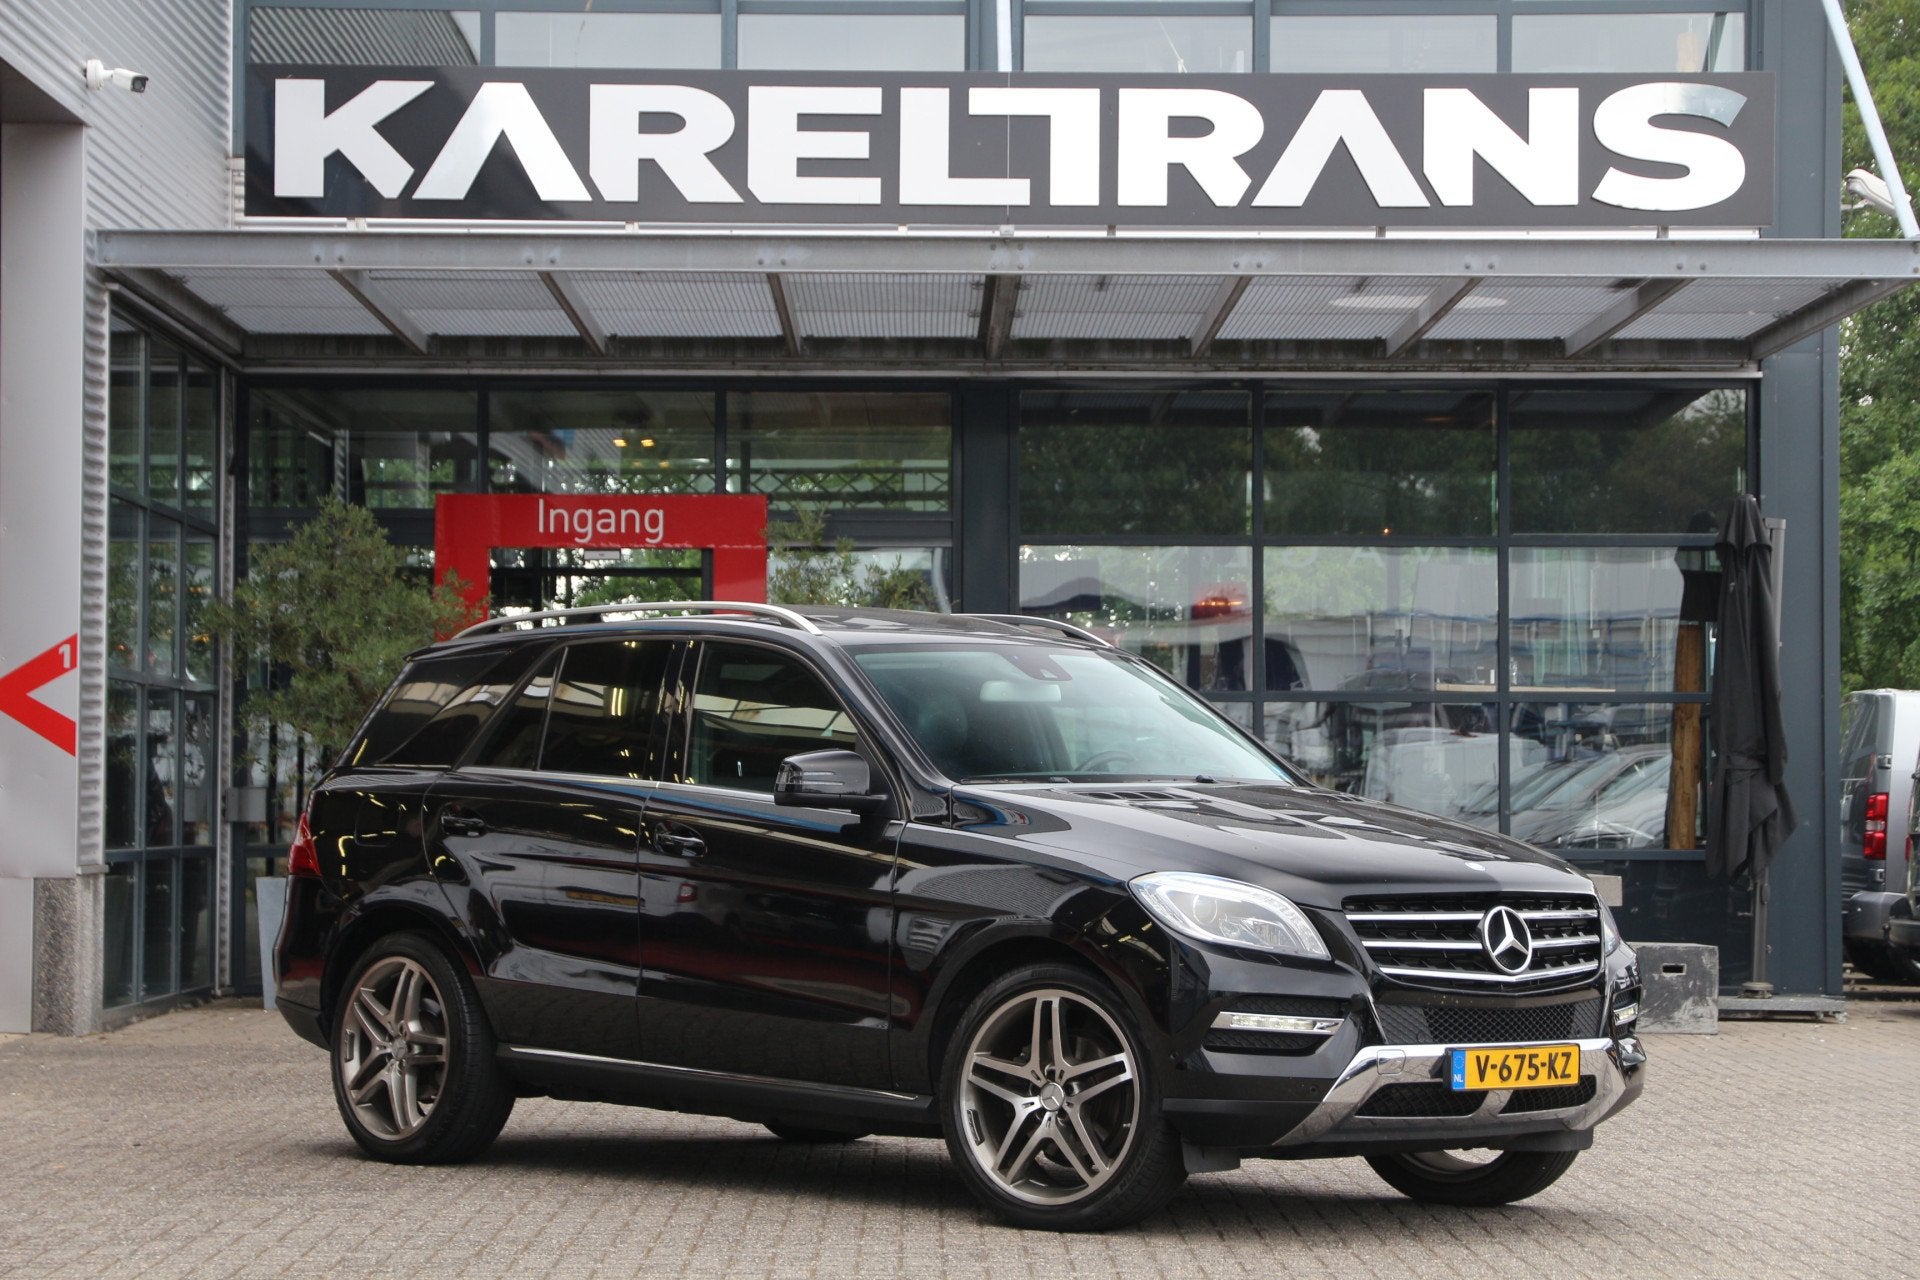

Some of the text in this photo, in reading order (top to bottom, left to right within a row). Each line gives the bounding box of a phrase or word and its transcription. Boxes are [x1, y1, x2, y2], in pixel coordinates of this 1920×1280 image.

[538, 498, 665, 544] Ingang
[58, 643, 71, 669] 1
[1453, 1073, 1464, 1083] NL
[1475, 1051, 1572, 1083] V-675-KZ
